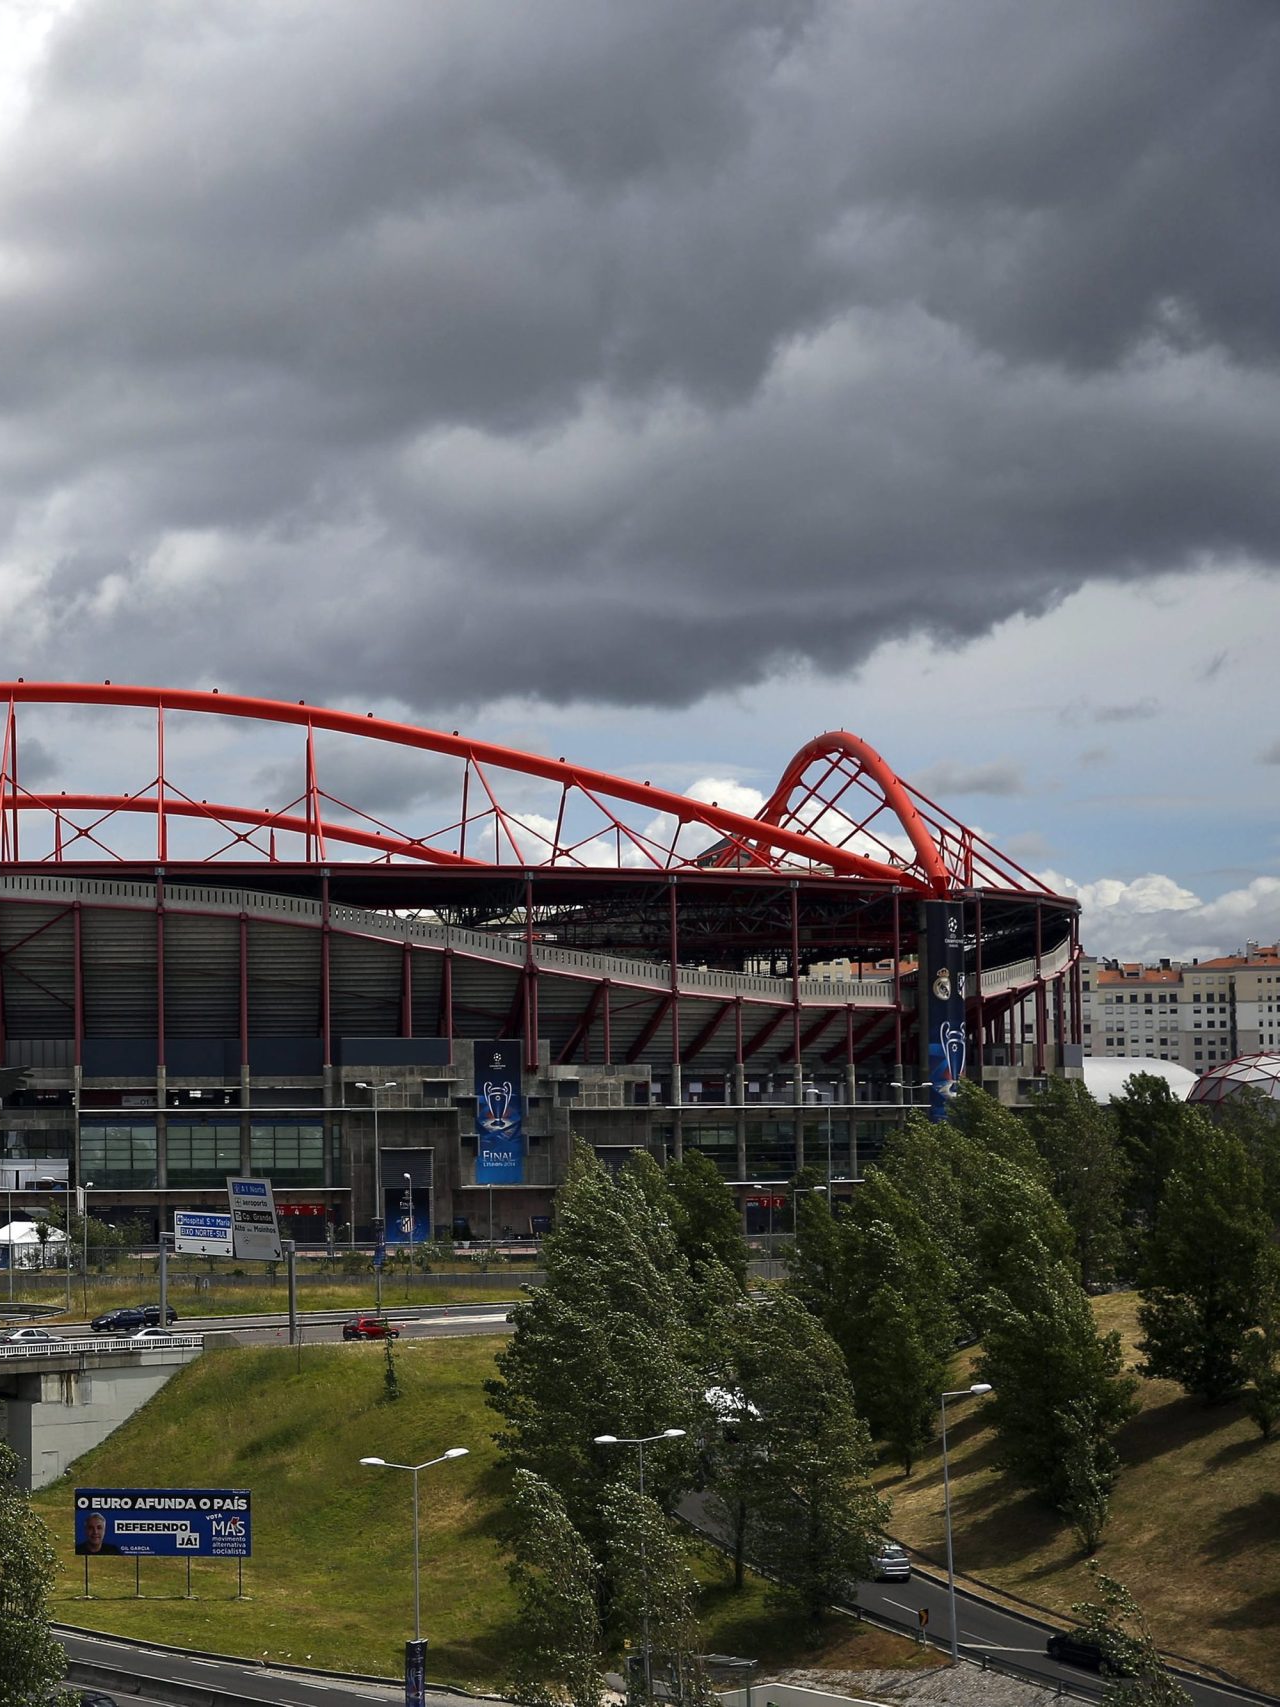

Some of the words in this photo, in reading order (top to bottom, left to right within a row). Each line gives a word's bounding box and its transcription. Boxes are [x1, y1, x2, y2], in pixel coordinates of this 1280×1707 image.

[483, 1150, 512, 1161] FINAL
[184, 1216, 205, 1225] Hospital
[216, 1218, 230, 1227] Maria
[195, 1228, 227, 1238] NORTE-SUL
[77, 1497, 89, 1509] O
[91, 1497, 133, 1509] EURO
[134, 1498, 197, 1510] AFUNDA
[199, 1498, 211, 1510] O
[213, 1496, 248, 1511] PAÍS
[205, 1512, 223, 1521] VOTA
[116, 1523, 189, 1532] REFERENDO
[178, 1534, 198, 1546] JÁ!
